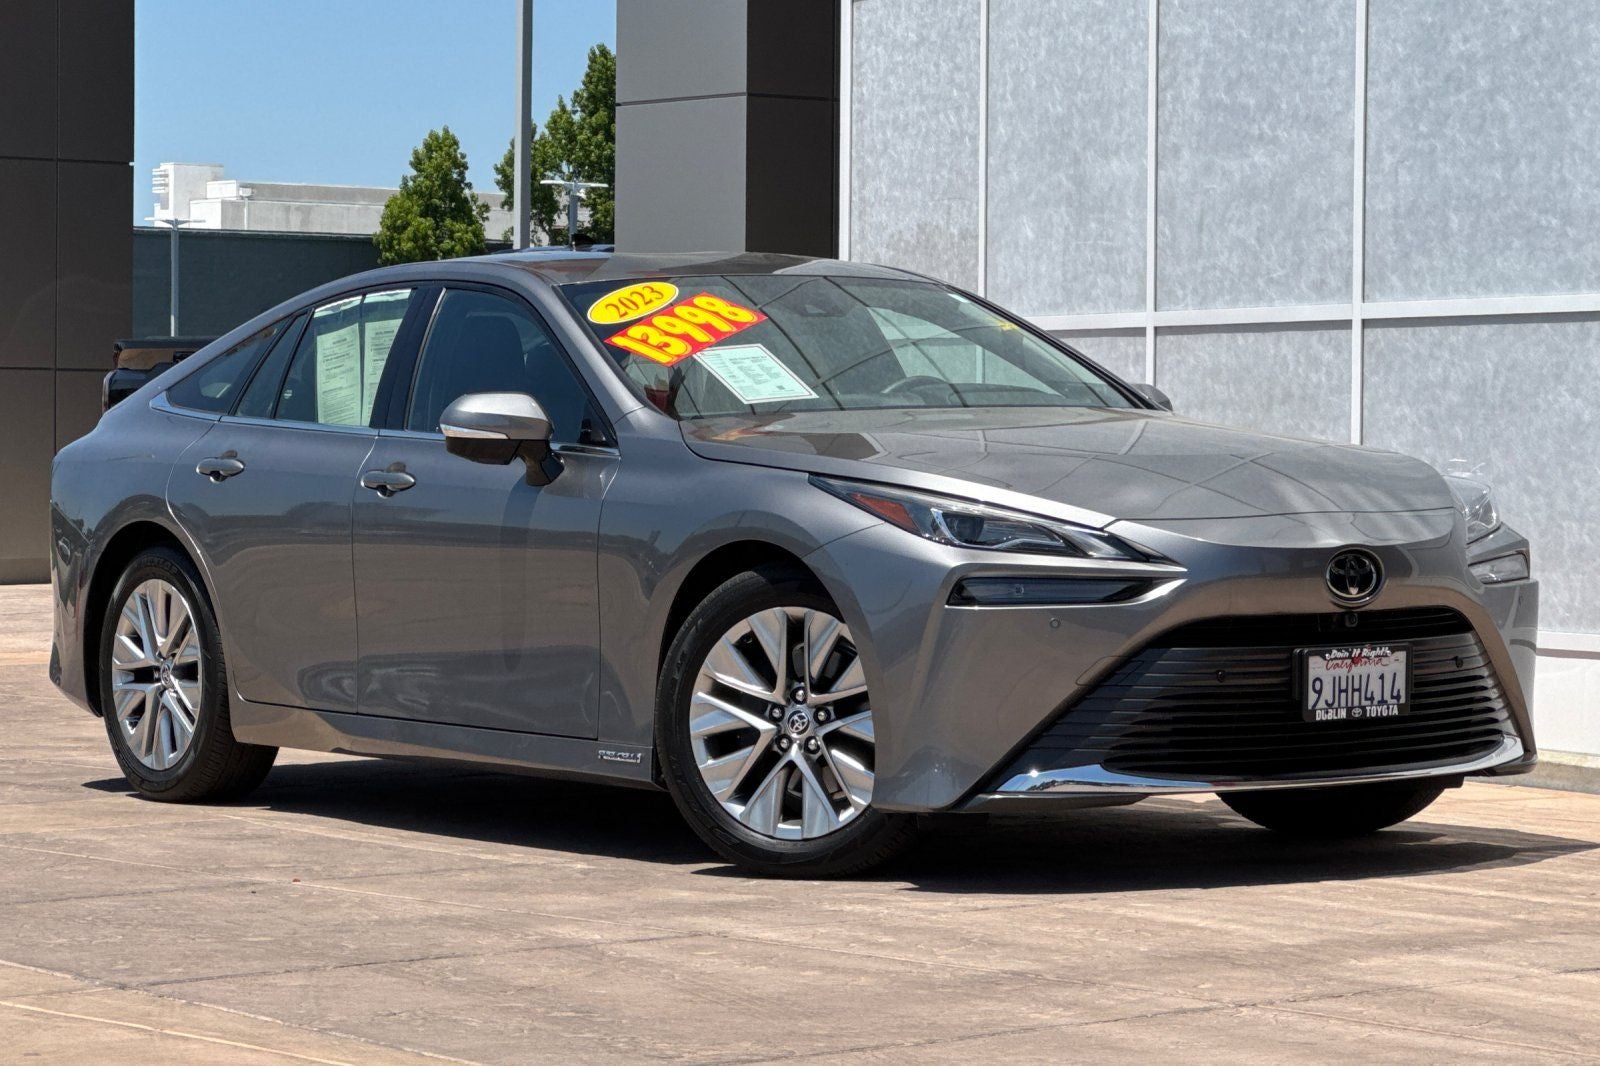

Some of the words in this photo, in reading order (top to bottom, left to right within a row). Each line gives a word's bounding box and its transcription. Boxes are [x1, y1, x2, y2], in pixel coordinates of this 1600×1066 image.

[605, 286, 664, 317] 2023
[611, 295, 757, 363] 13998
[1312, 672, 1401, 709] 9JHH414
[1315, 708, 1347, 721] DUBLIN
[1366, 704, 1399, 717] TOYOTA
